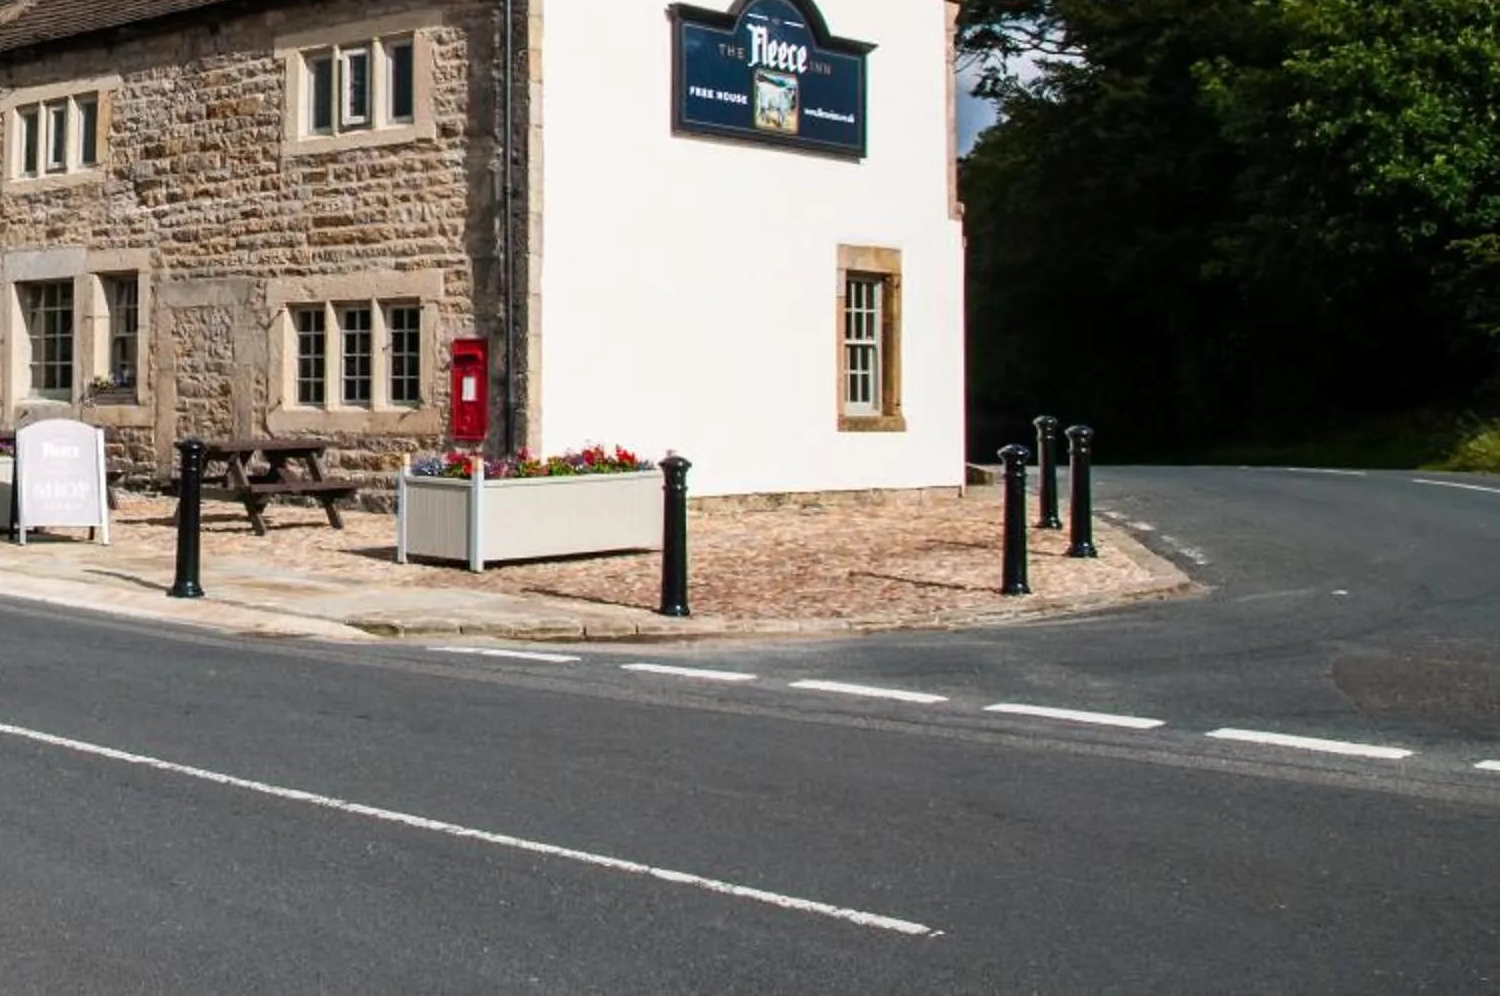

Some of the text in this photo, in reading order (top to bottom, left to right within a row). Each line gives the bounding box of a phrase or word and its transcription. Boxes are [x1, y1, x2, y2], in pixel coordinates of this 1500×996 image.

[718, 23, 832, 76] THE Fleece INN
[689, 85, 748, 105] FREE HOUSE
